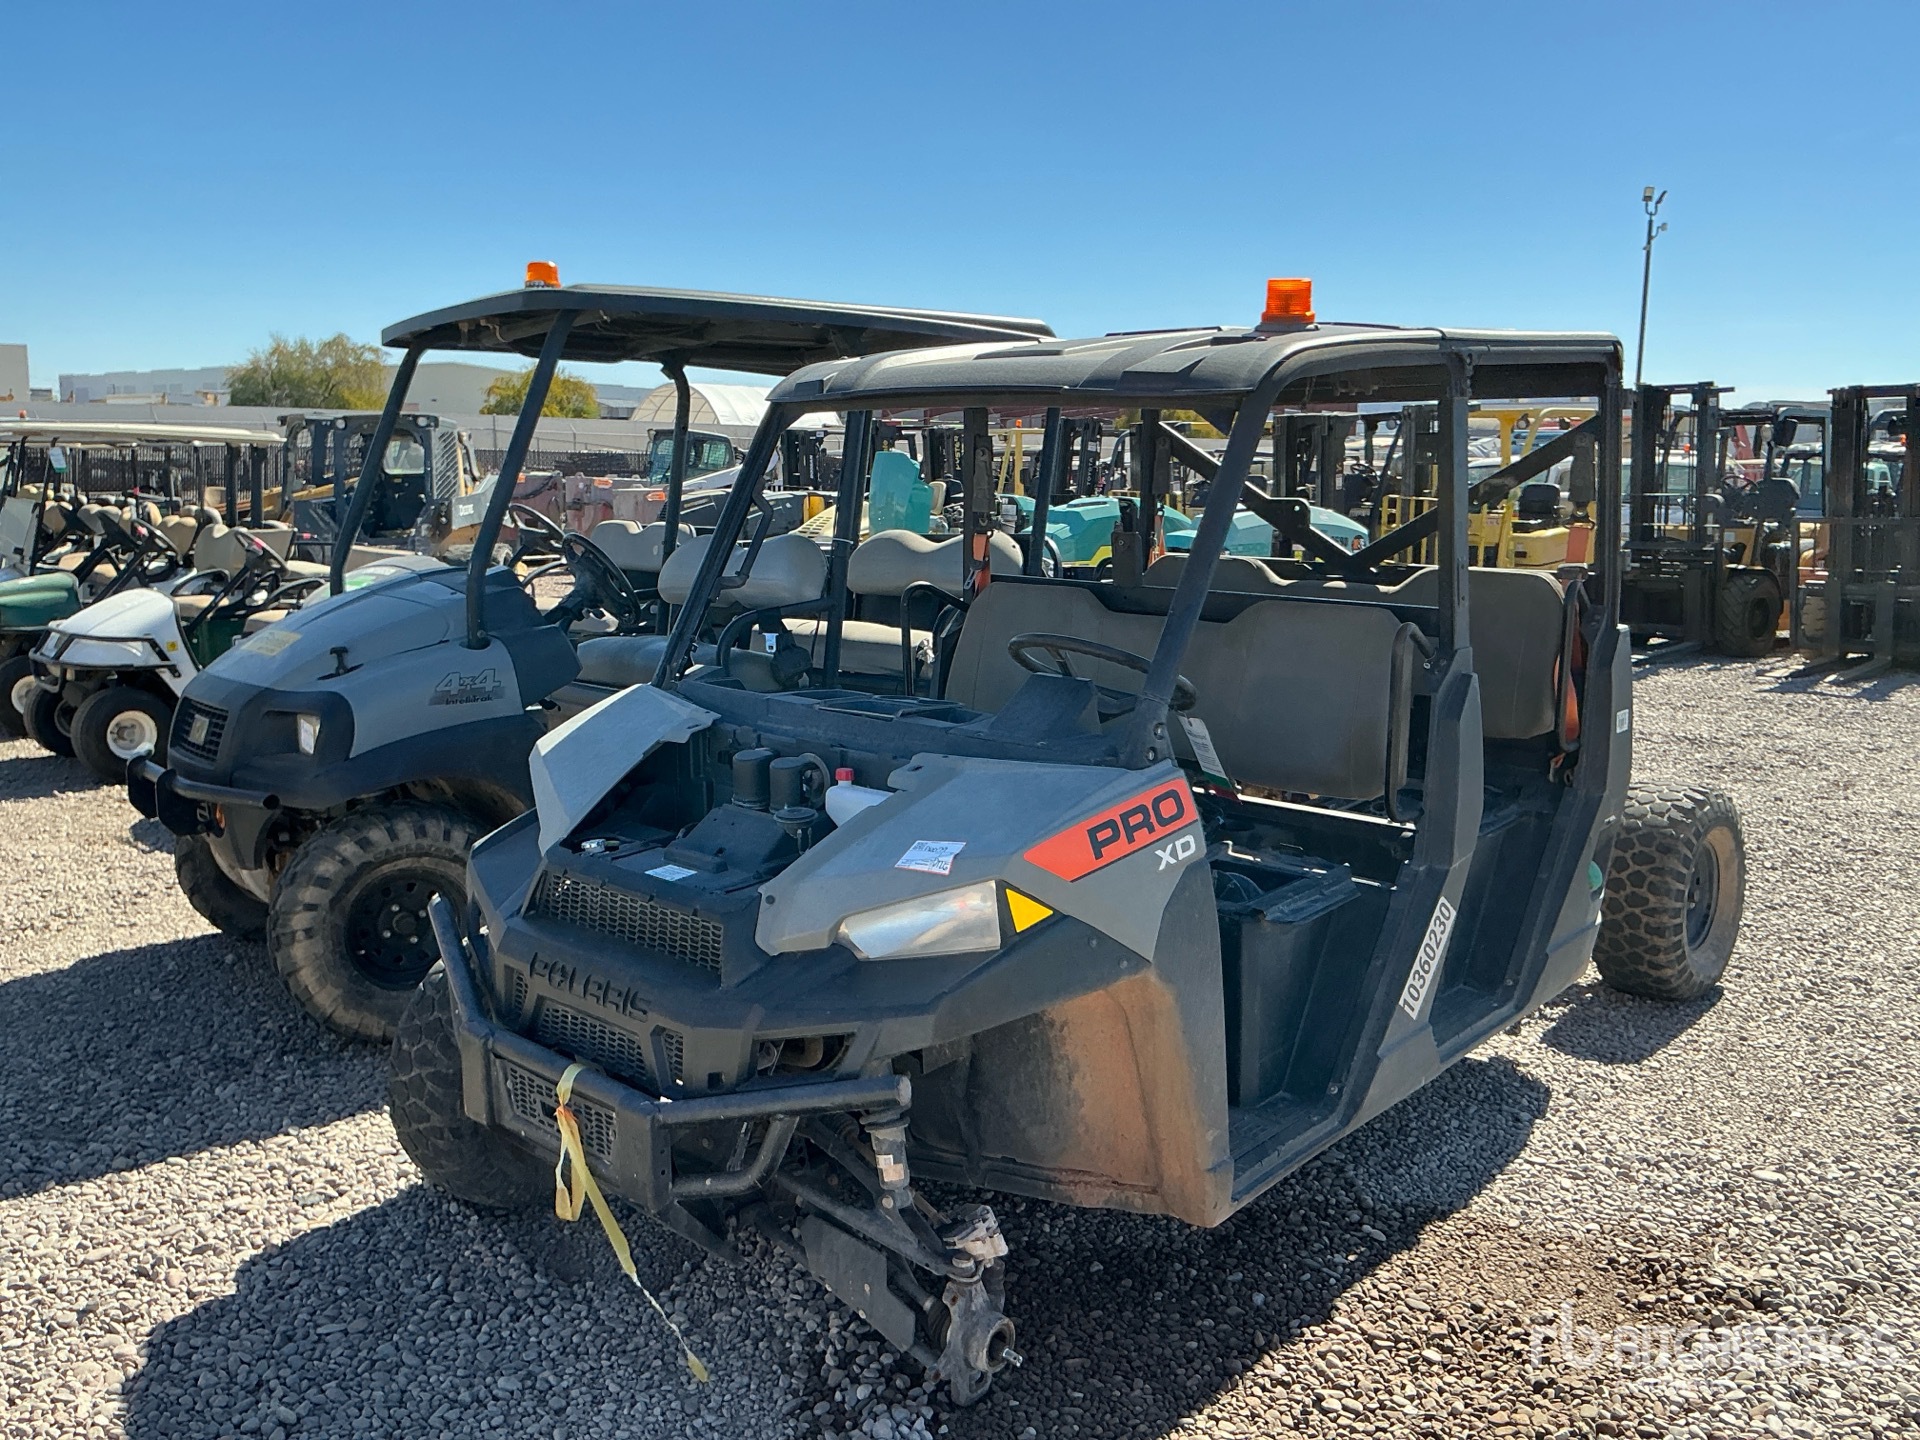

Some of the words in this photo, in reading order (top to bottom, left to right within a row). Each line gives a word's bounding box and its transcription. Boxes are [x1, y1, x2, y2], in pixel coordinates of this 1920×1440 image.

[953, 435, 962, 471] HYSTER
[1086, 457, 1094, 486] TOYOTA
[435, 668, 502, 696] 4x4
[1087, 789, 1185, 860] PRO
[1154, 834, 1196, 871] XD
[1402, 902, 1451, 1012] 10360230
[529, 951, 653, 1024] POLARIS
